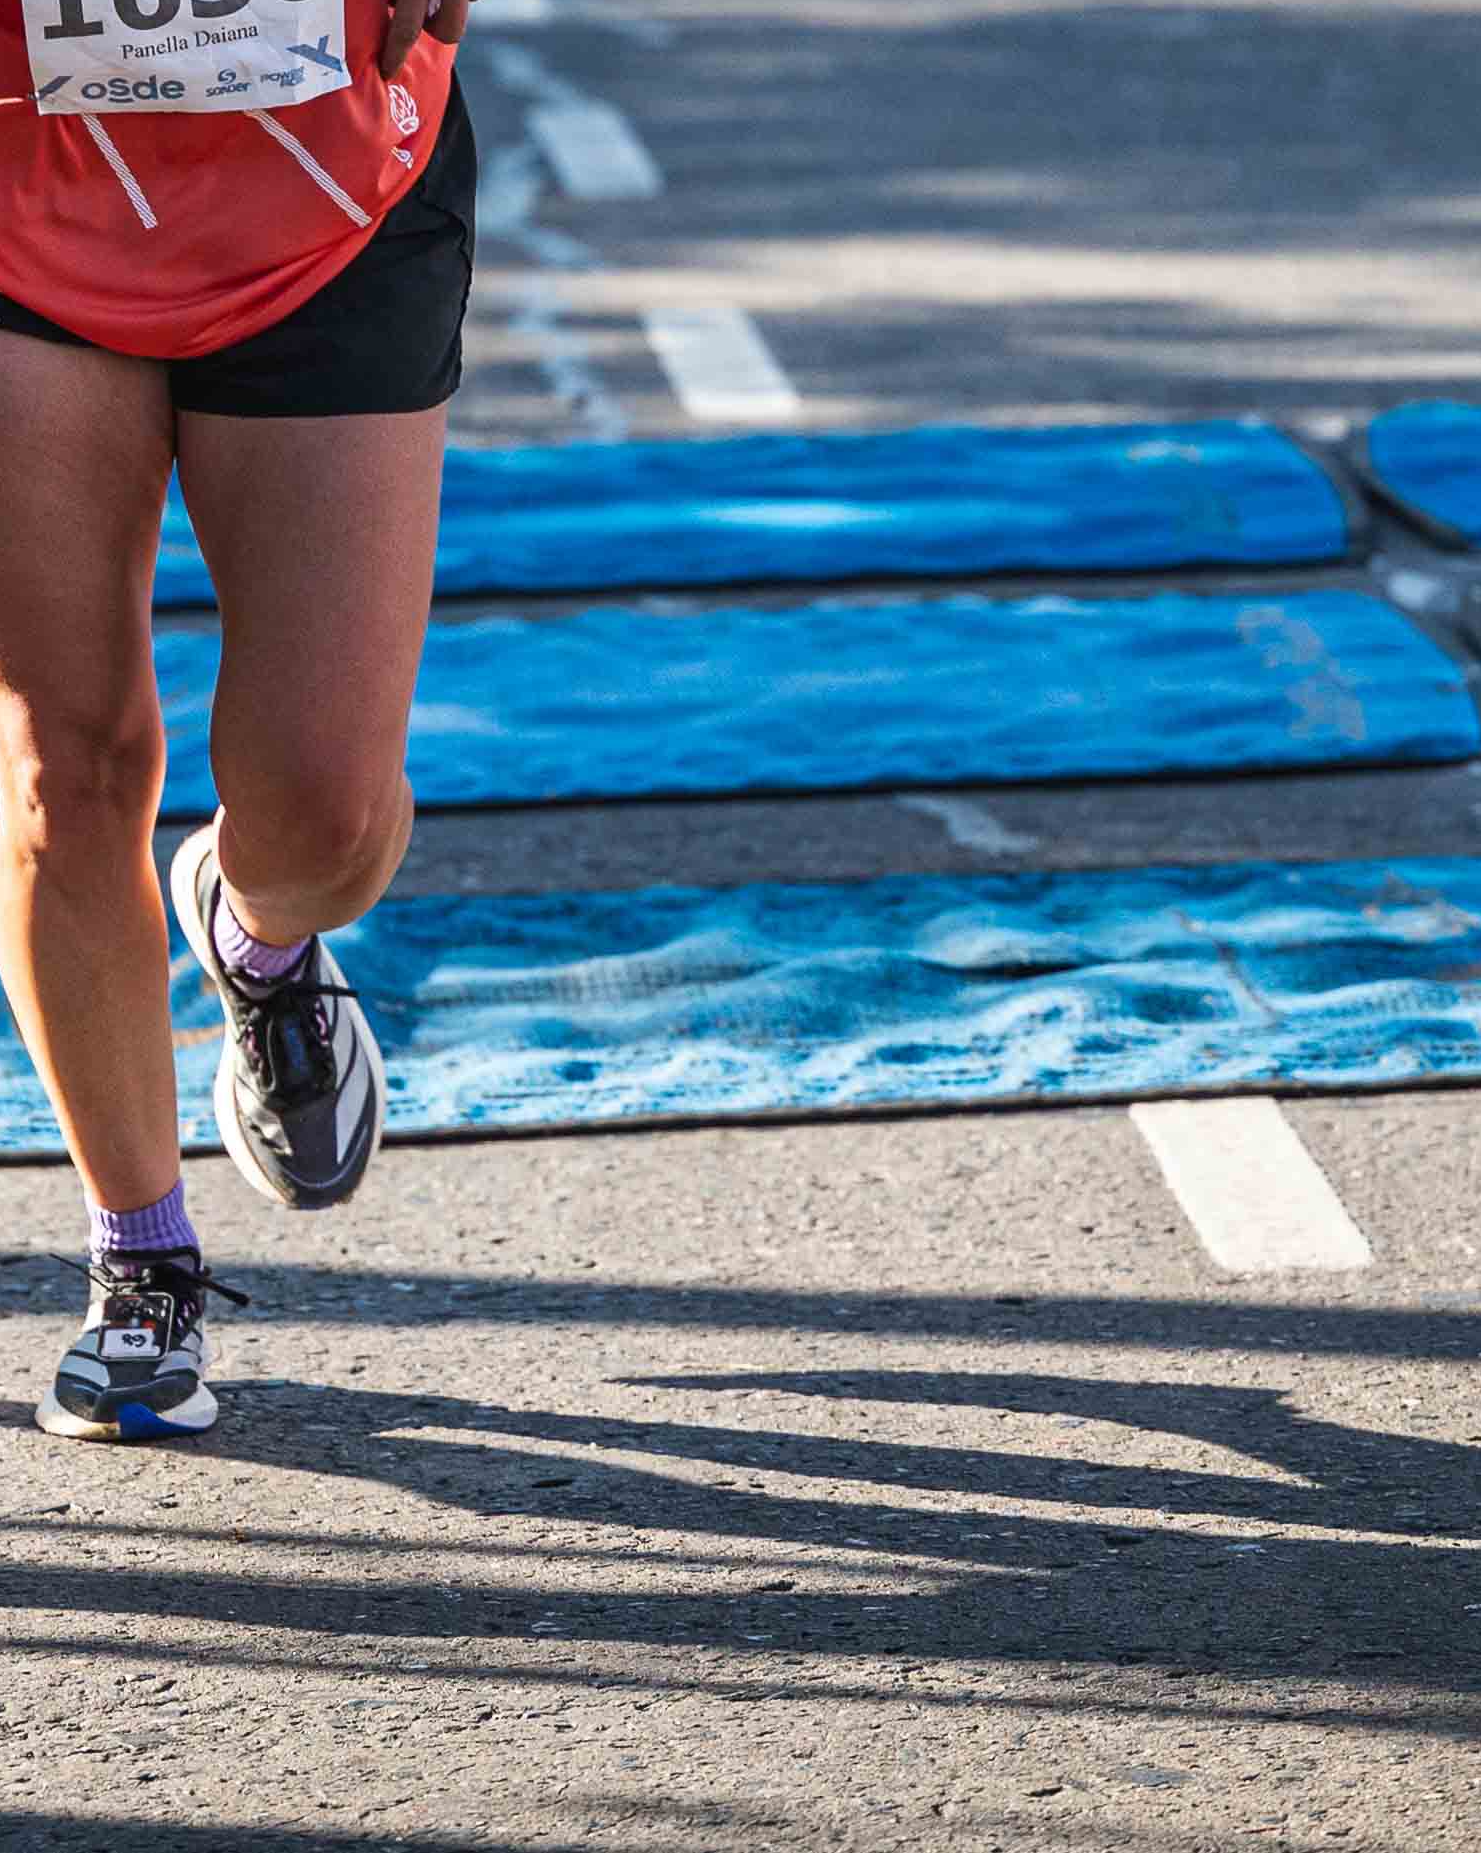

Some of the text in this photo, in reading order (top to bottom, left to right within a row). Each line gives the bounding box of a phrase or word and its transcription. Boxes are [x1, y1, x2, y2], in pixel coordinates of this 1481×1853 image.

[122, 23, 260, 60] Panella Daiana
[81, 75, 186, 104] osde
